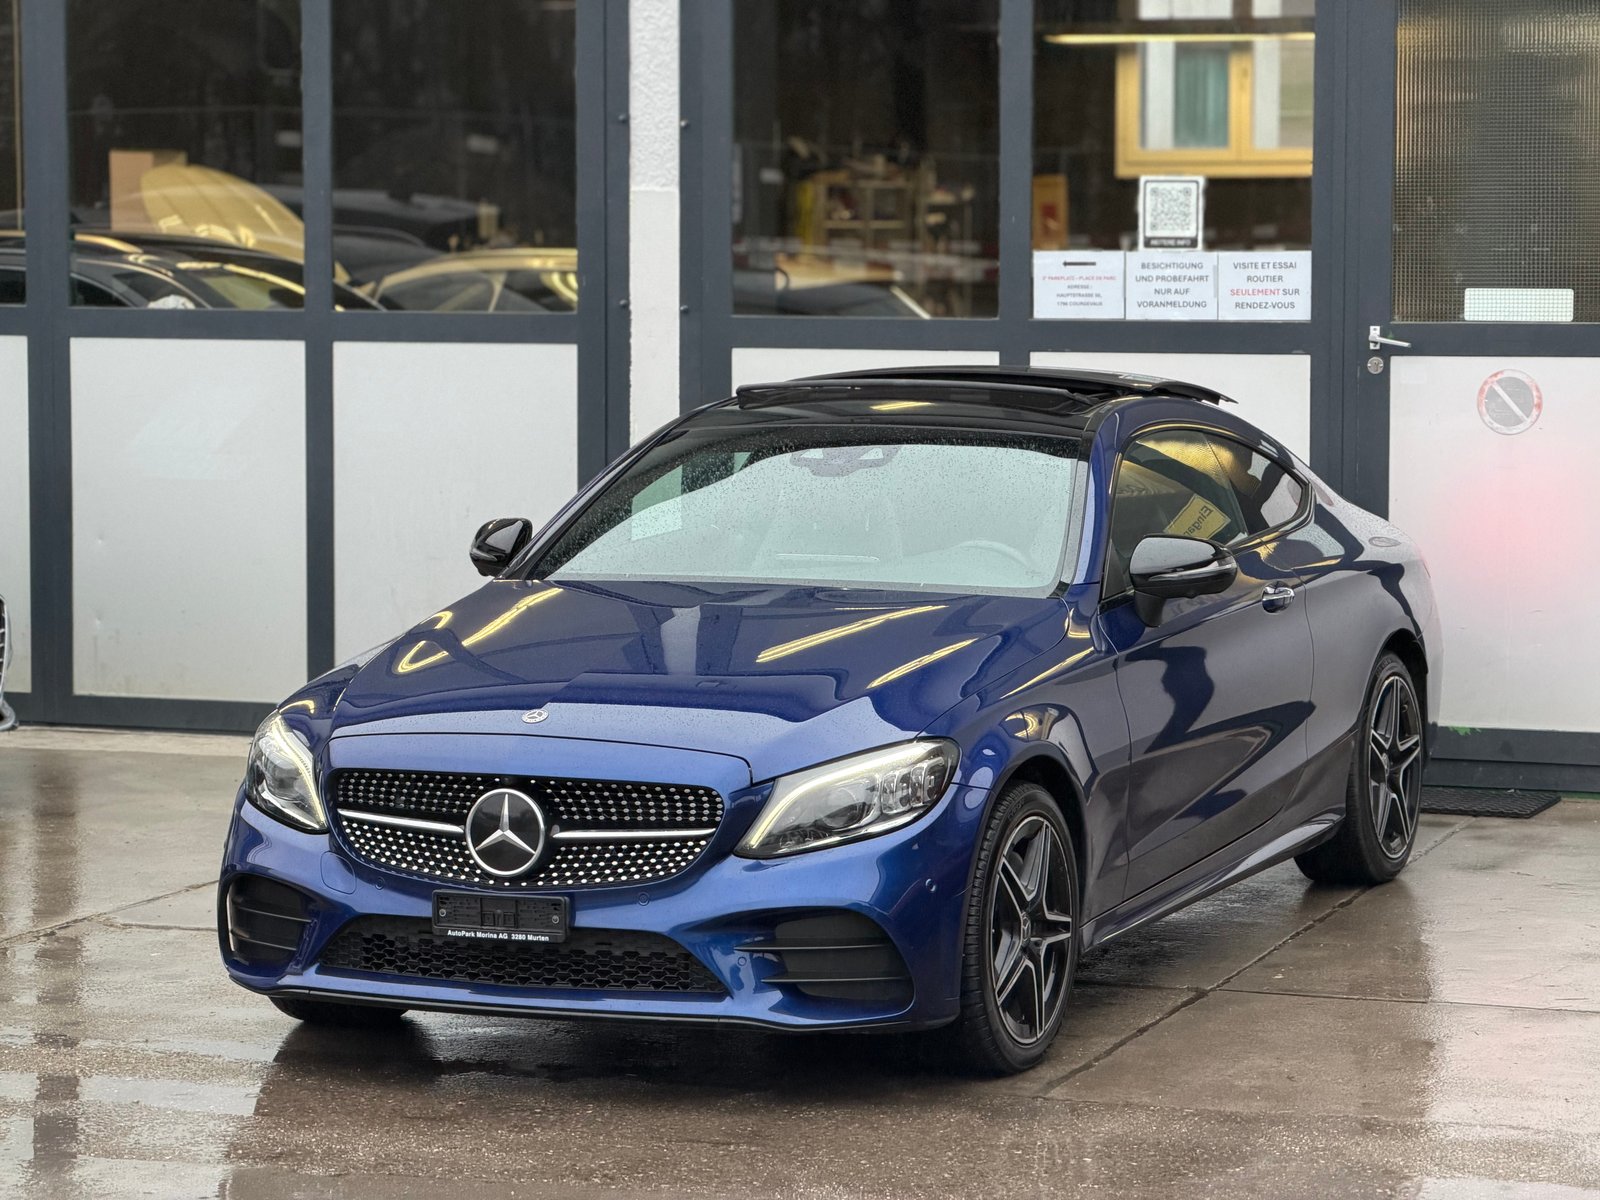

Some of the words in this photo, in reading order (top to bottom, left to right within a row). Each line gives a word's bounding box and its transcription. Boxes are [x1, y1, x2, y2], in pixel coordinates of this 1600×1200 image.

[1141, 262, 1204, 270] BESICHTIGUNG
[1233, 262, 1259, 270] VISITE
[1261, 262, 1271, 270] ET
[1272, 262, 1297, 270] ESSAI
[1135, 275, 1154, 283] UND
[1155, 275, 1209, 283] PROBEFAHRT
[1246, 275, 1284, 283] ROUTIER
[1154, 288, 1172, 296] NUR
[1173, 288, 1191, 296] AUF
[1230, 288, 1280, 296] SEULEMENT
[1282, 288, 1300, 296] SUR
[1137, 301, 1207, 309] VORANMELDUNG
[1234, 302, 1296, 310] RENDEZ-VOUS
[447, 929, 475, 938] AutoPark
[476, 931, 498, 939] Morina
